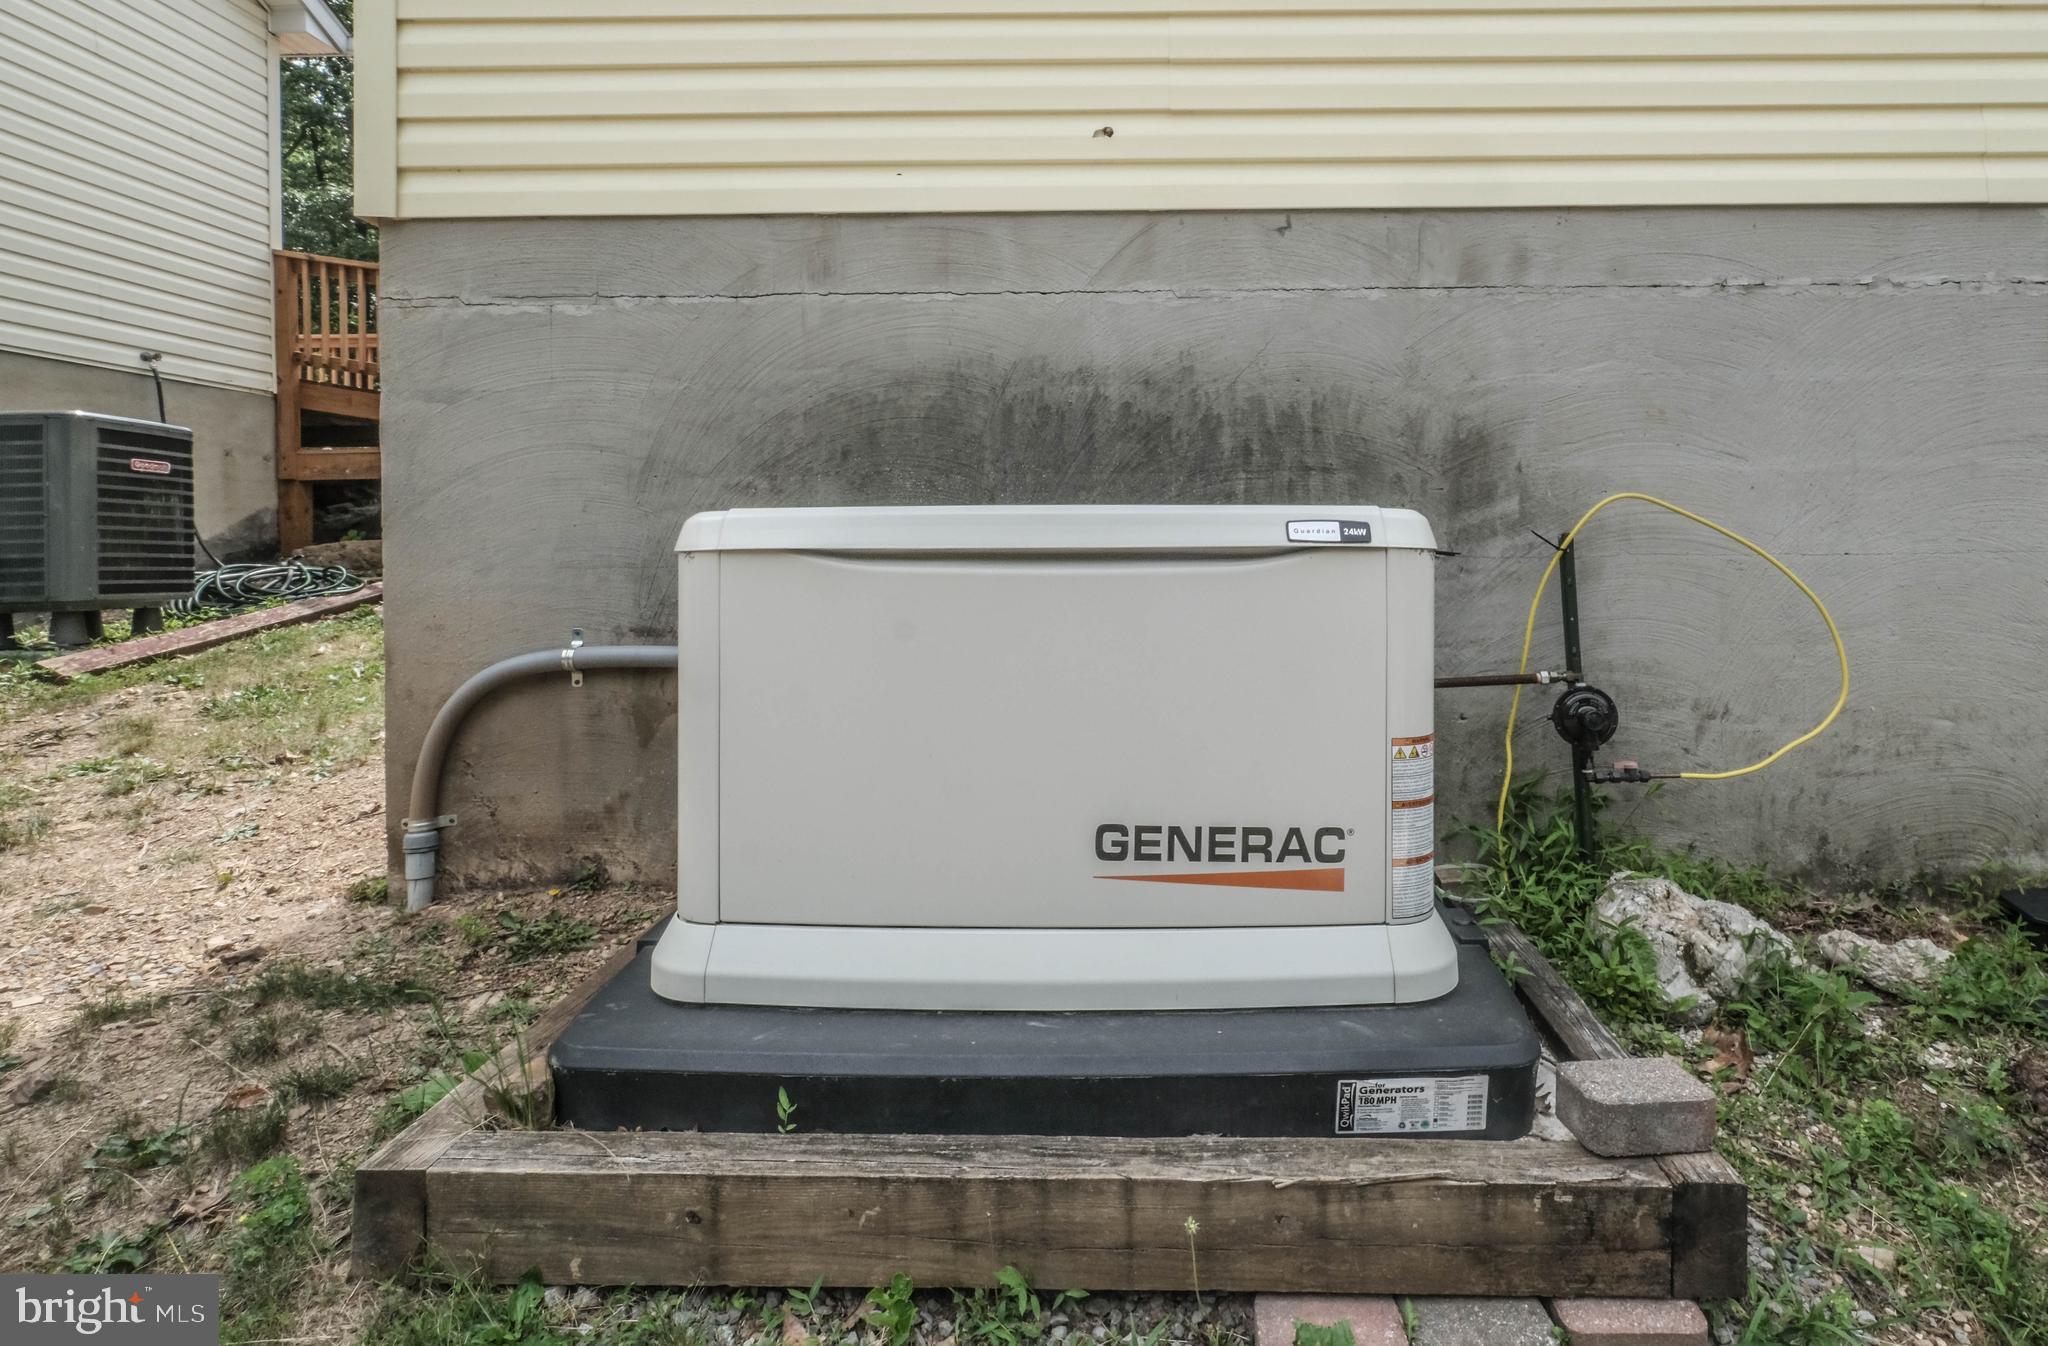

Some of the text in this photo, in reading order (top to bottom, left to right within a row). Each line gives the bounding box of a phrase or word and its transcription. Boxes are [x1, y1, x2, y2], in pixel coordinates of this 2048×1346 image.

[1343, 527, 1367, 536] 24kW
[1359, 1086, 1425, 1095] Generators
[1359, 1095, 1397, 1105] 180 MPH
[1340, 1086, 1351, 1128] QwikPad
